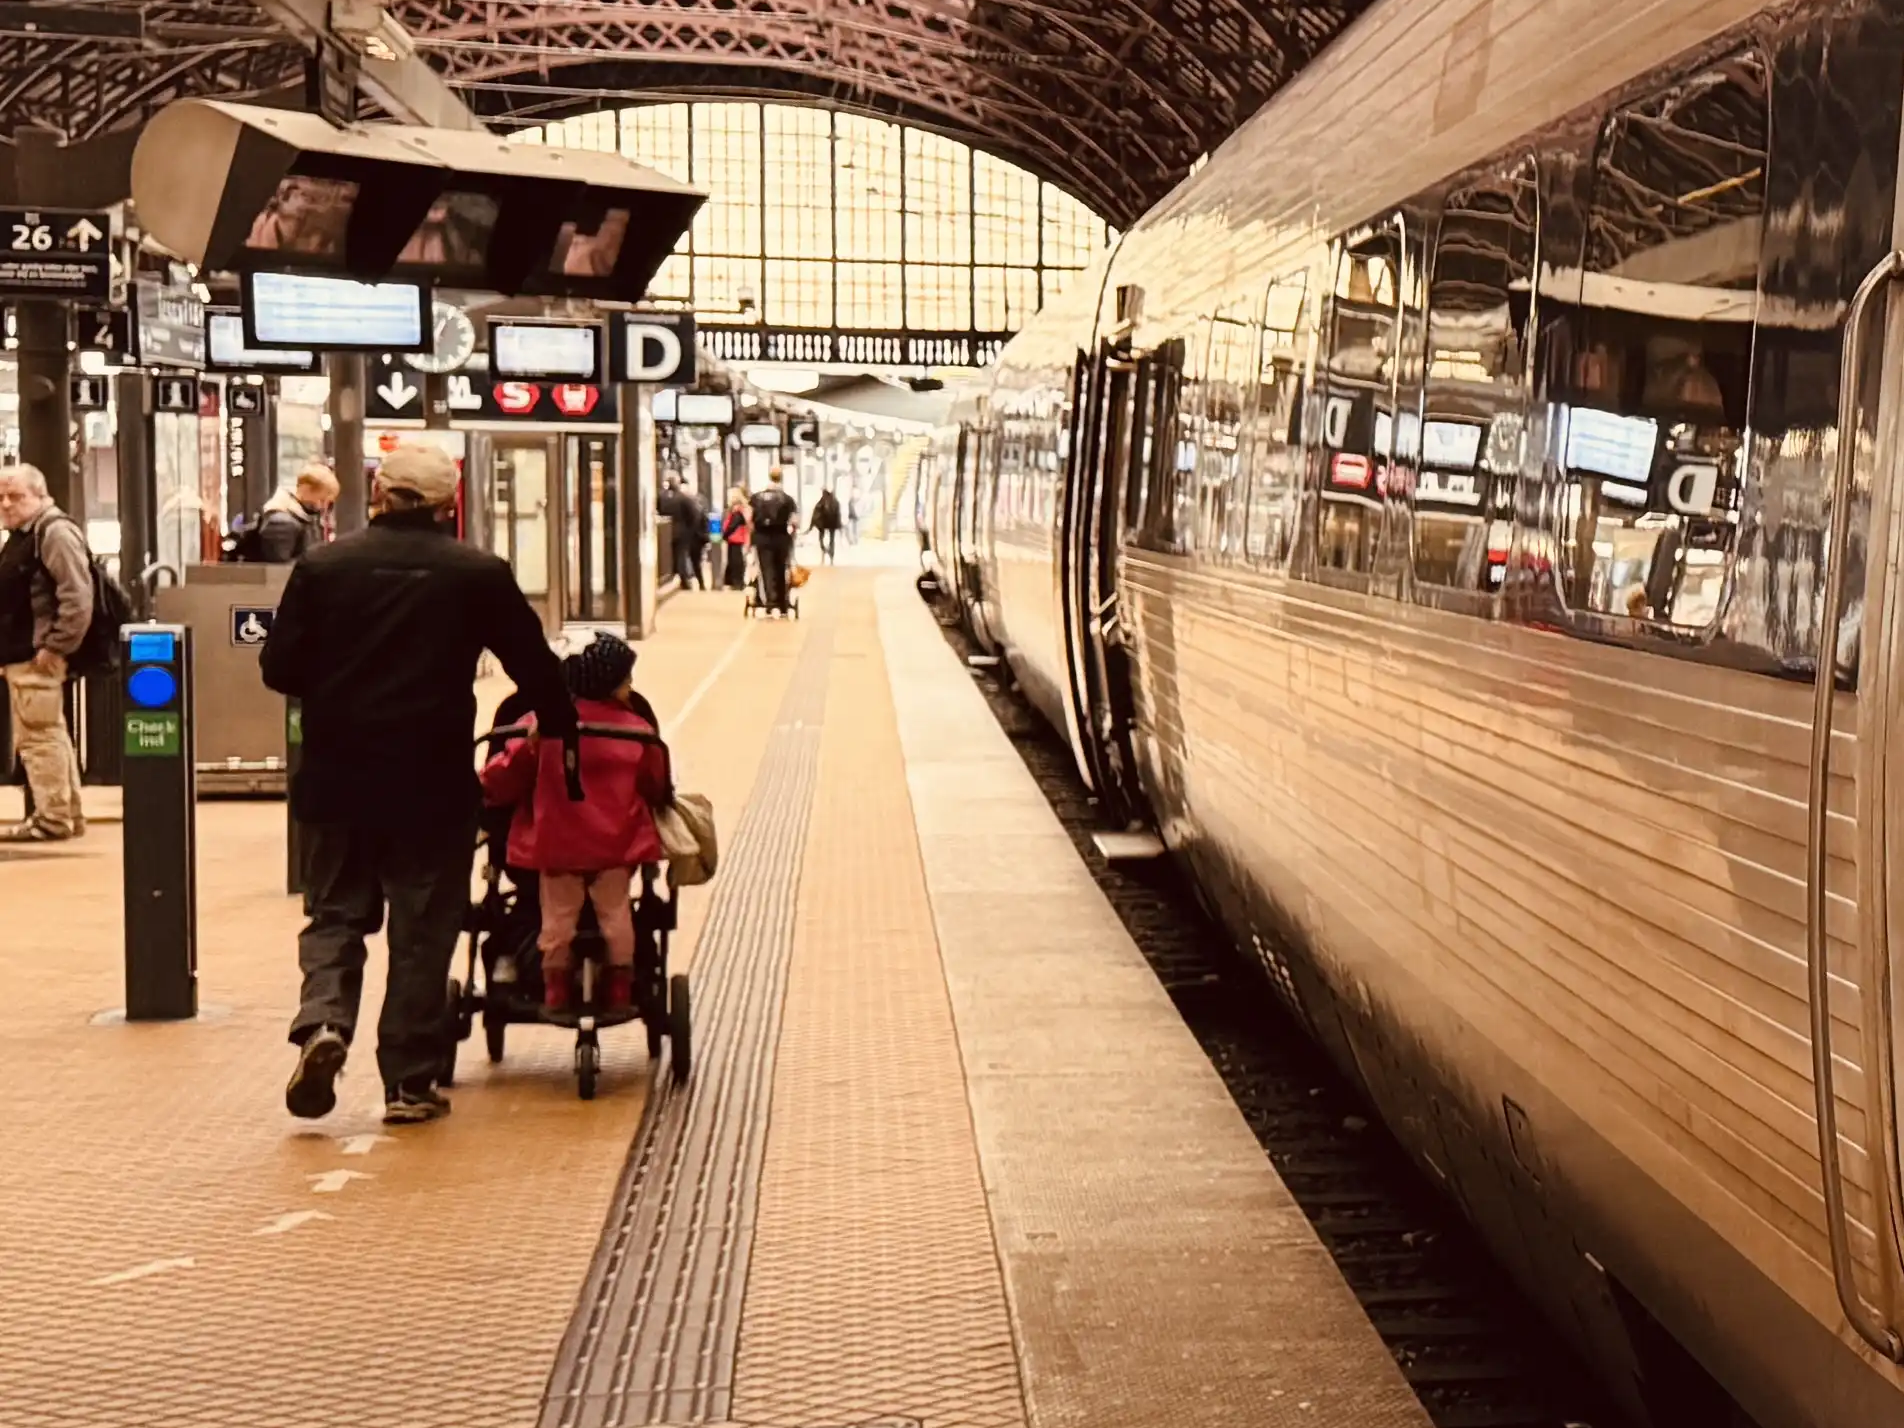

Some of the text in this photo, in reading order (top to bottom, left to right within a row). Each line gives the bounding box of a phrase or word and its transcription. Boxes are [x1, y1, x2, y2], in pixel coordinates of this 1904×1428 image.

[12, 224, 52, 251] 26
[626, 324, 681, 380] D
[503, 382, 531, 408] S
